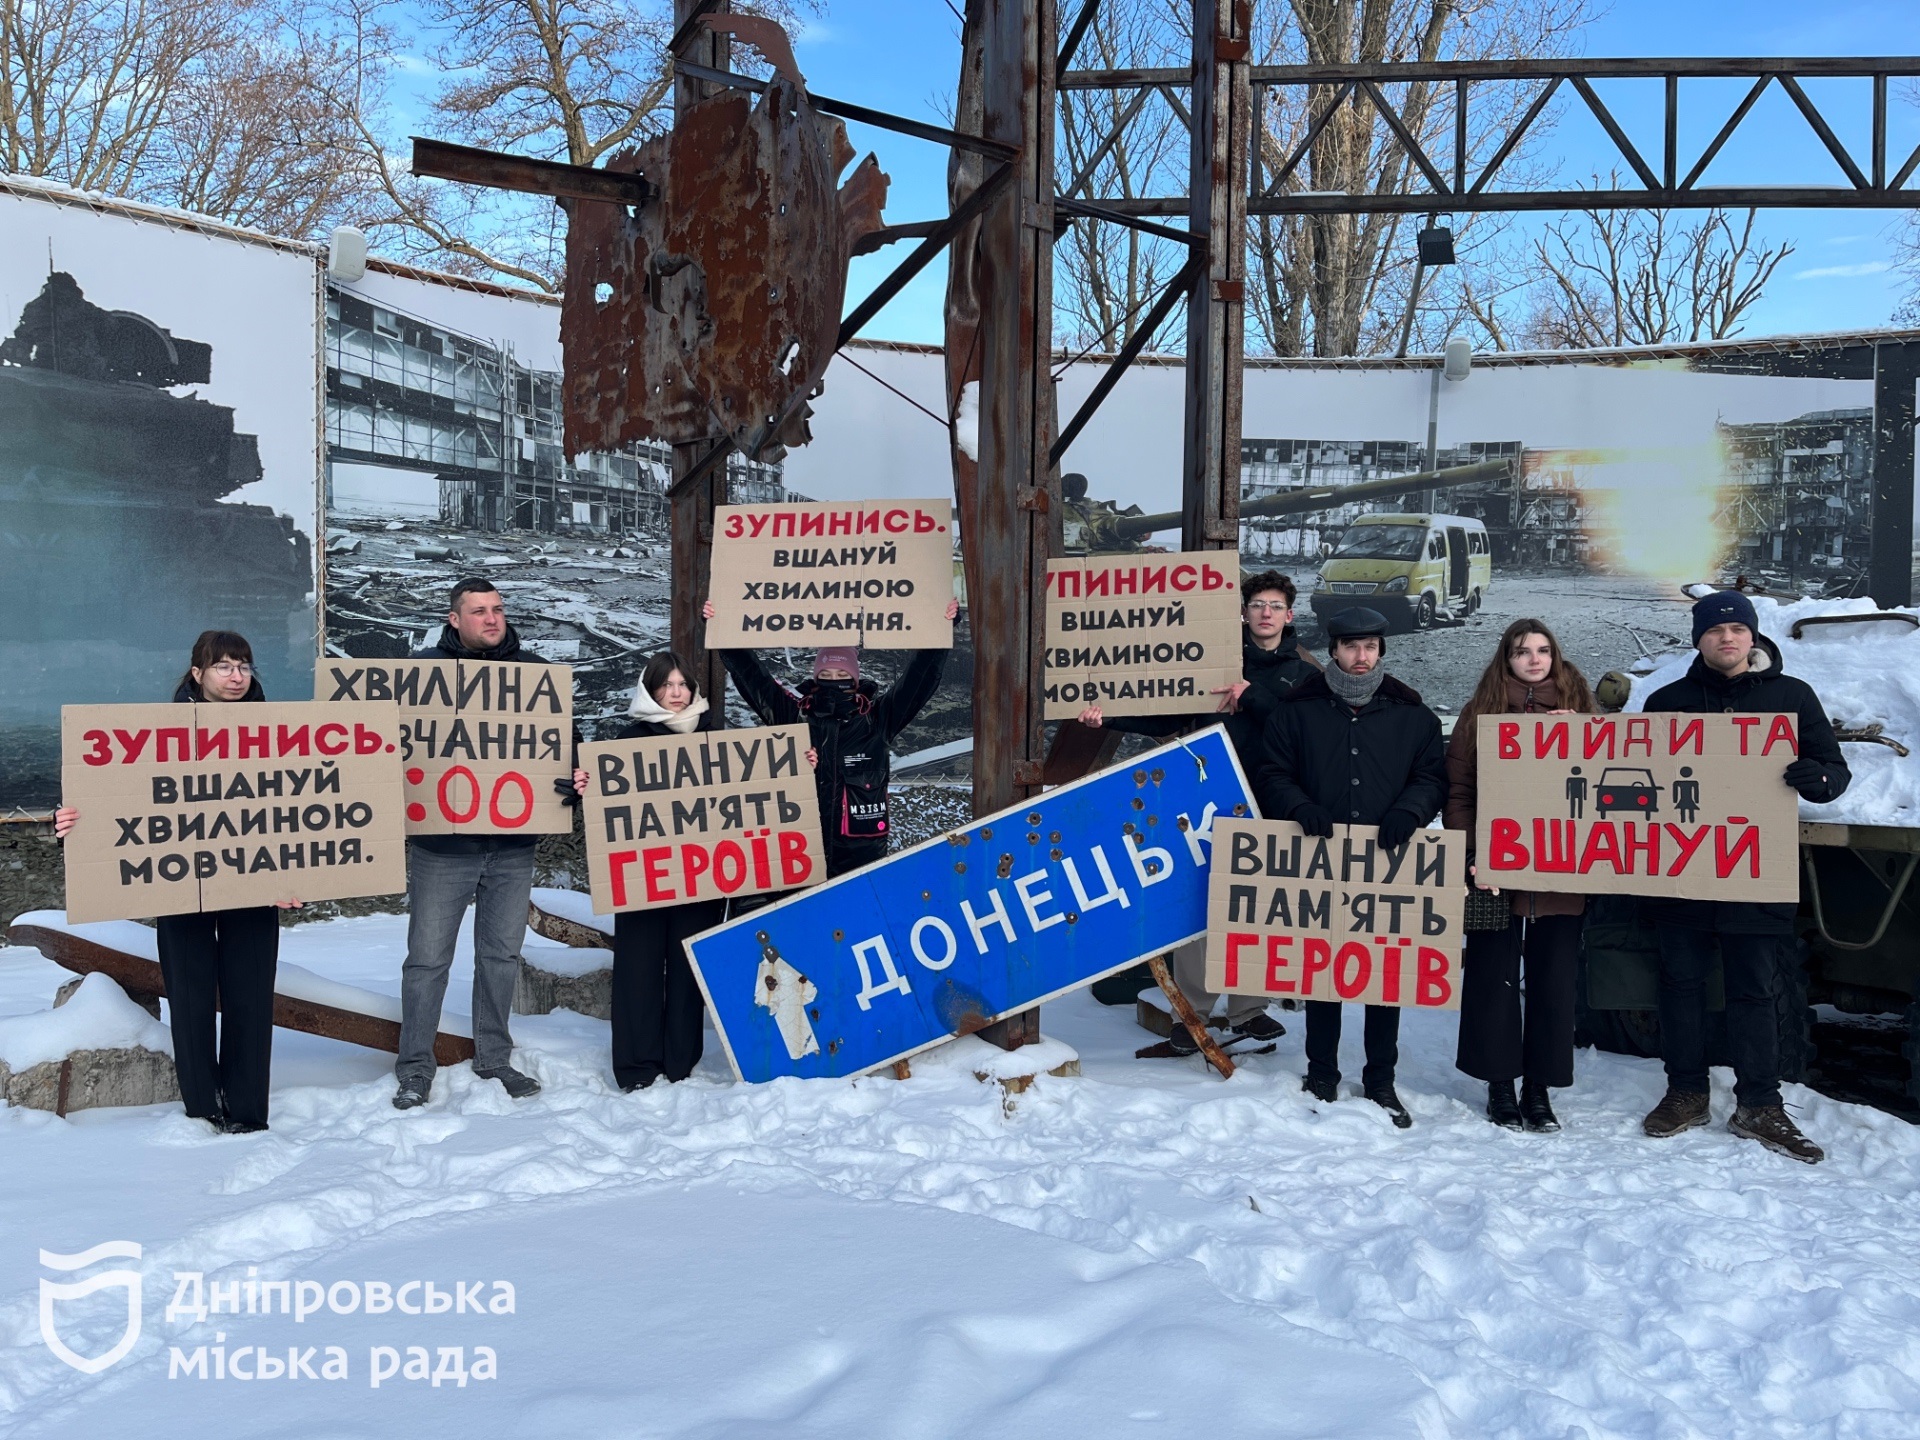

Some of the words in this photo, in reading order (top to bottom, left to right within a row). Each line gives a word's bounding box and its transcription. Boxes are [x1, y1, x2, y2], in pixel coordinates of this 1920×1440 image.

[724, 508, 947, 539] ЗУПИНИСЬ.
[772, 540, 897, 568] ВШАНУЙ
[741, 579, 915, 600] ХВИЛИНОЮ
[741, 612, 912, 632] МОВЧАННЯ.
[1061, 600, 1186, 632] ВШАНУЙ
[329, 663, 563, 713] ХВИЛИНА
[1044, 677, 1205, 703] МОВЧАННЯ.
[82, 722, 397, 767] ЗУПИНИСЬ.
[1498, 716, 1704, 760] ВИЙДИ
[1732, 714, 1799, 757] ТА
[152, 760, 341, 804] ВШАНУЙ
[597, 731, 799, 797] ВШАНУЙ
[114, 801, 373, 847] ХВИЛИНОЮ
[603, 790, 802, 843] ПАМ'ЯТЬ
[119, 838, 374, 885] МОВЧАННЯ.
[608, 828, 813, 907] ГЕРОЇВ
[1230, 831, 1447, 888] ВШАНУЙ
[1489, 816, 1761, 879] ВШАНУЙ
[849, 801, 1219, 1011] ДОНЕЦЬК
[1227, 884, 1448, 936] ПАМ'ЯТЬ
[1224, 932, 1452, 1007] ГЕРОЇВ
